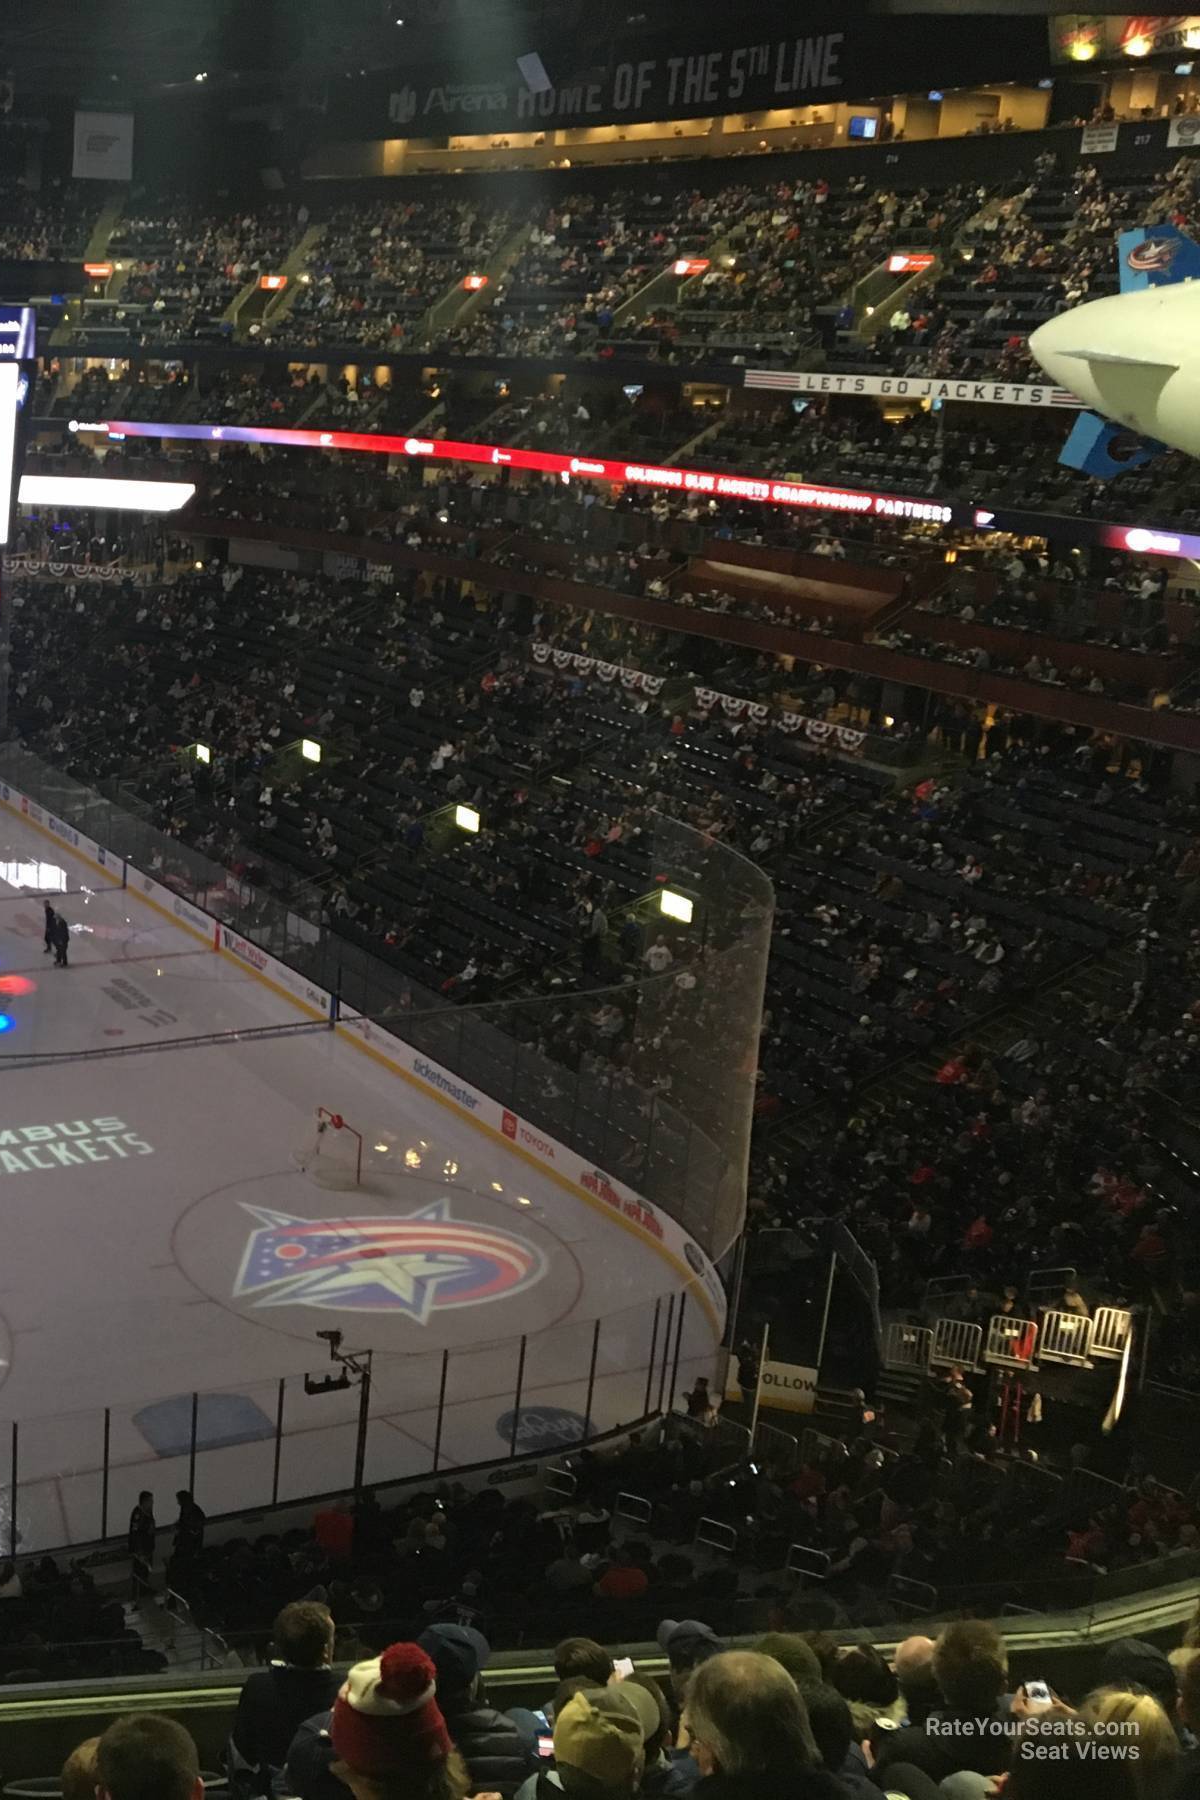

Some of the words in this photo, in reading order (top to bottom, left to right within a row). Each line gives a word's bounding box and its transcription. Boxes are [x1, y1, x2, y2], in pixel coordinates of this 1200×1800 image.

[613, 60, 657, 111] OF
[667, 52, 722, 105] THE
[775, 32, 845, 94] LINE
[423, 87, 508, 115] Arena
[806, 376, 865, 392] LET'S
[881, 380, 908, 395] GO
[921, 382, 1044, 402] JACKETS
[625, 465, 683, 486] COLUMBUS
[717, 478, 770, 499] JACKETS
[772, 485, 873, 512] CHAMPIONSHIP
[875, 498, 952, 522] PARTNERS
[413, 1058, 479, 1110] ticketmaster
[520, 1128, 556, 1159] TOYOTA
